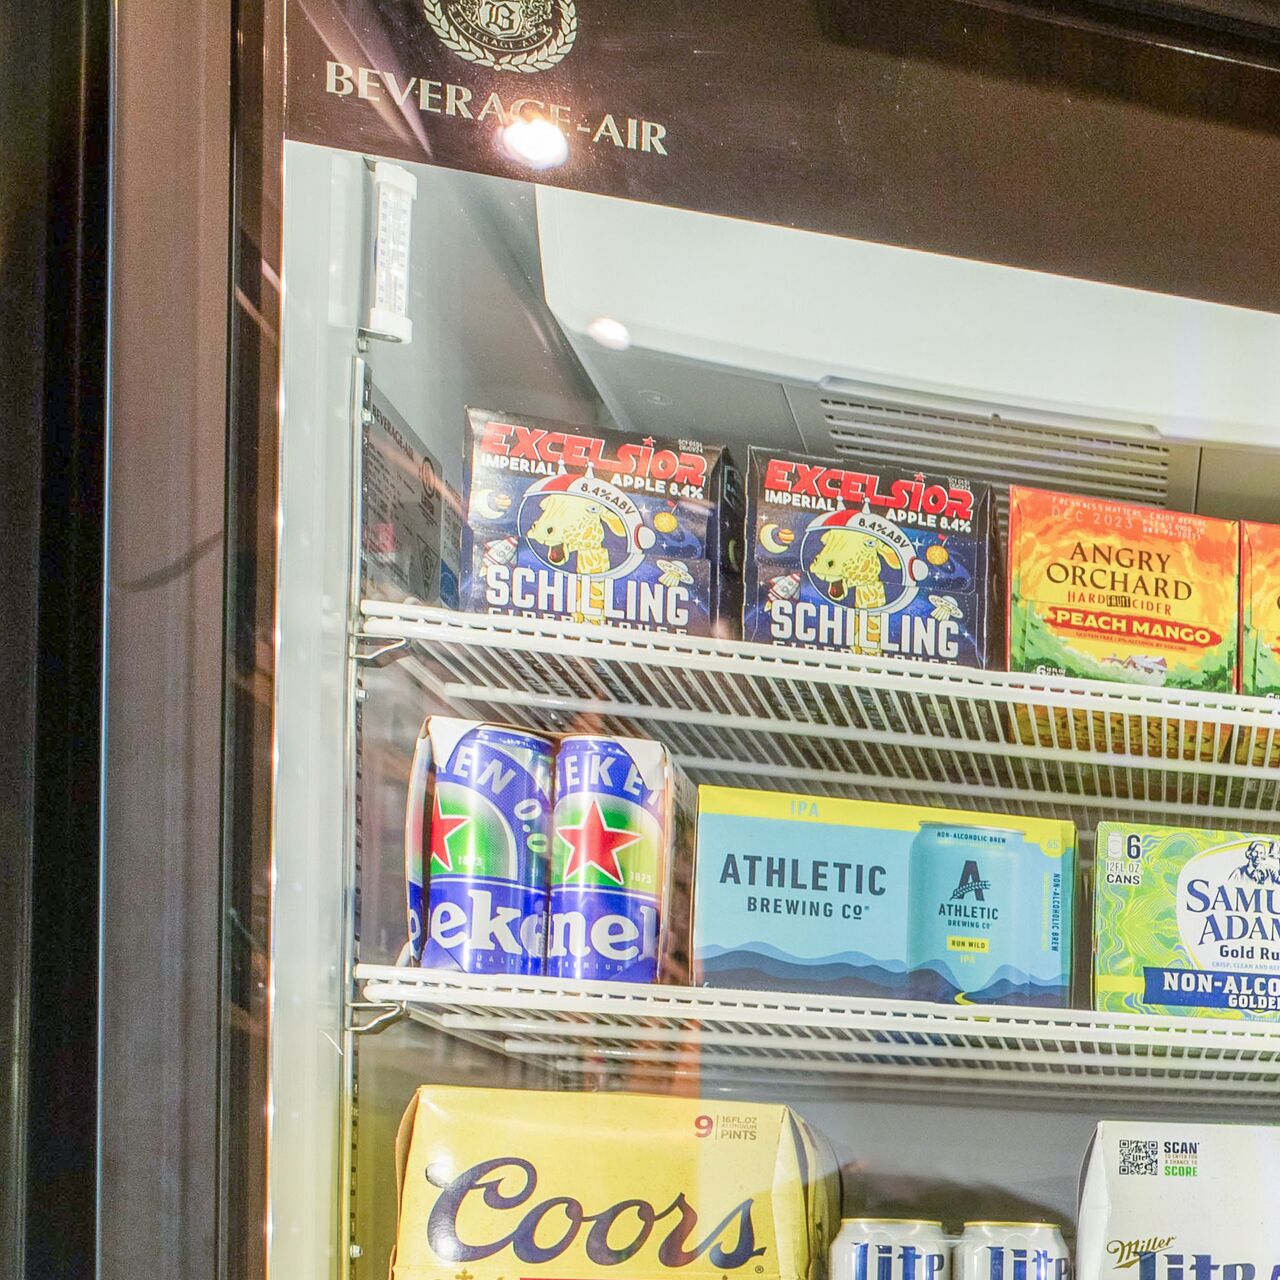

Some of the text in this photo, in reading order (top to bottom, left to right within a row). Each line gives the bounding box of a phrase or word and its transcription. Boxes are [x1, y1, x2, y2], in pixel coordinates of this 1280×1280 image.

[481, 421, 707, 486] EXCELSIOR
[481, 453, 704, 499] IMPERIAL APPLE 8.4%
[765, 459, 974, 521] EXCELSIOR
[765, 490, 971, 533] IMPERIAL APPLE 8.4%
[1051, 508, 1133, 530] DEC 2023
[1070, 541, 1171, 574] ANGRY
[1047, 563, 1193, 601] ORCHARD
[487, 564, 689, 626] SCHILLING
[1068, 591, 1106, 606] HARD
[1132, 599, 1171, 616] CIDER
[771, 600, 959, 658] SCHILLING
[1056, 610, 1211, 643] PEACH MANGO
[791, 801, 819, 818] IPA
[936, 831, 1006, 844] NON-ALCOHOLIC BREW
[1127, 834, 1141, 859] 6
[720, 853, 887, 896] ATHLETIC
[1107, 873, 1141, 886] CANS
[748, 896, 833, 918] BREWING
[938, 903, 999, 920] ATHLETIC
[1051, 873, 1061, 952] NON-ALCOHOLIC BREW
[951, 940, 986, 949] RUN WILD
[1219, 945, 1256, 960] Gold
[694, 1115, 714, 1138] 9
[721, 1129, 757, 1141] PINTS
[1164, 1142, 1198, 1154] SCAN
[1165, 1165, 1198, 1177] SCORE
[425, 1156, 768, 1270] Coors
[1106, 1236, 1176, 1270] Miller
